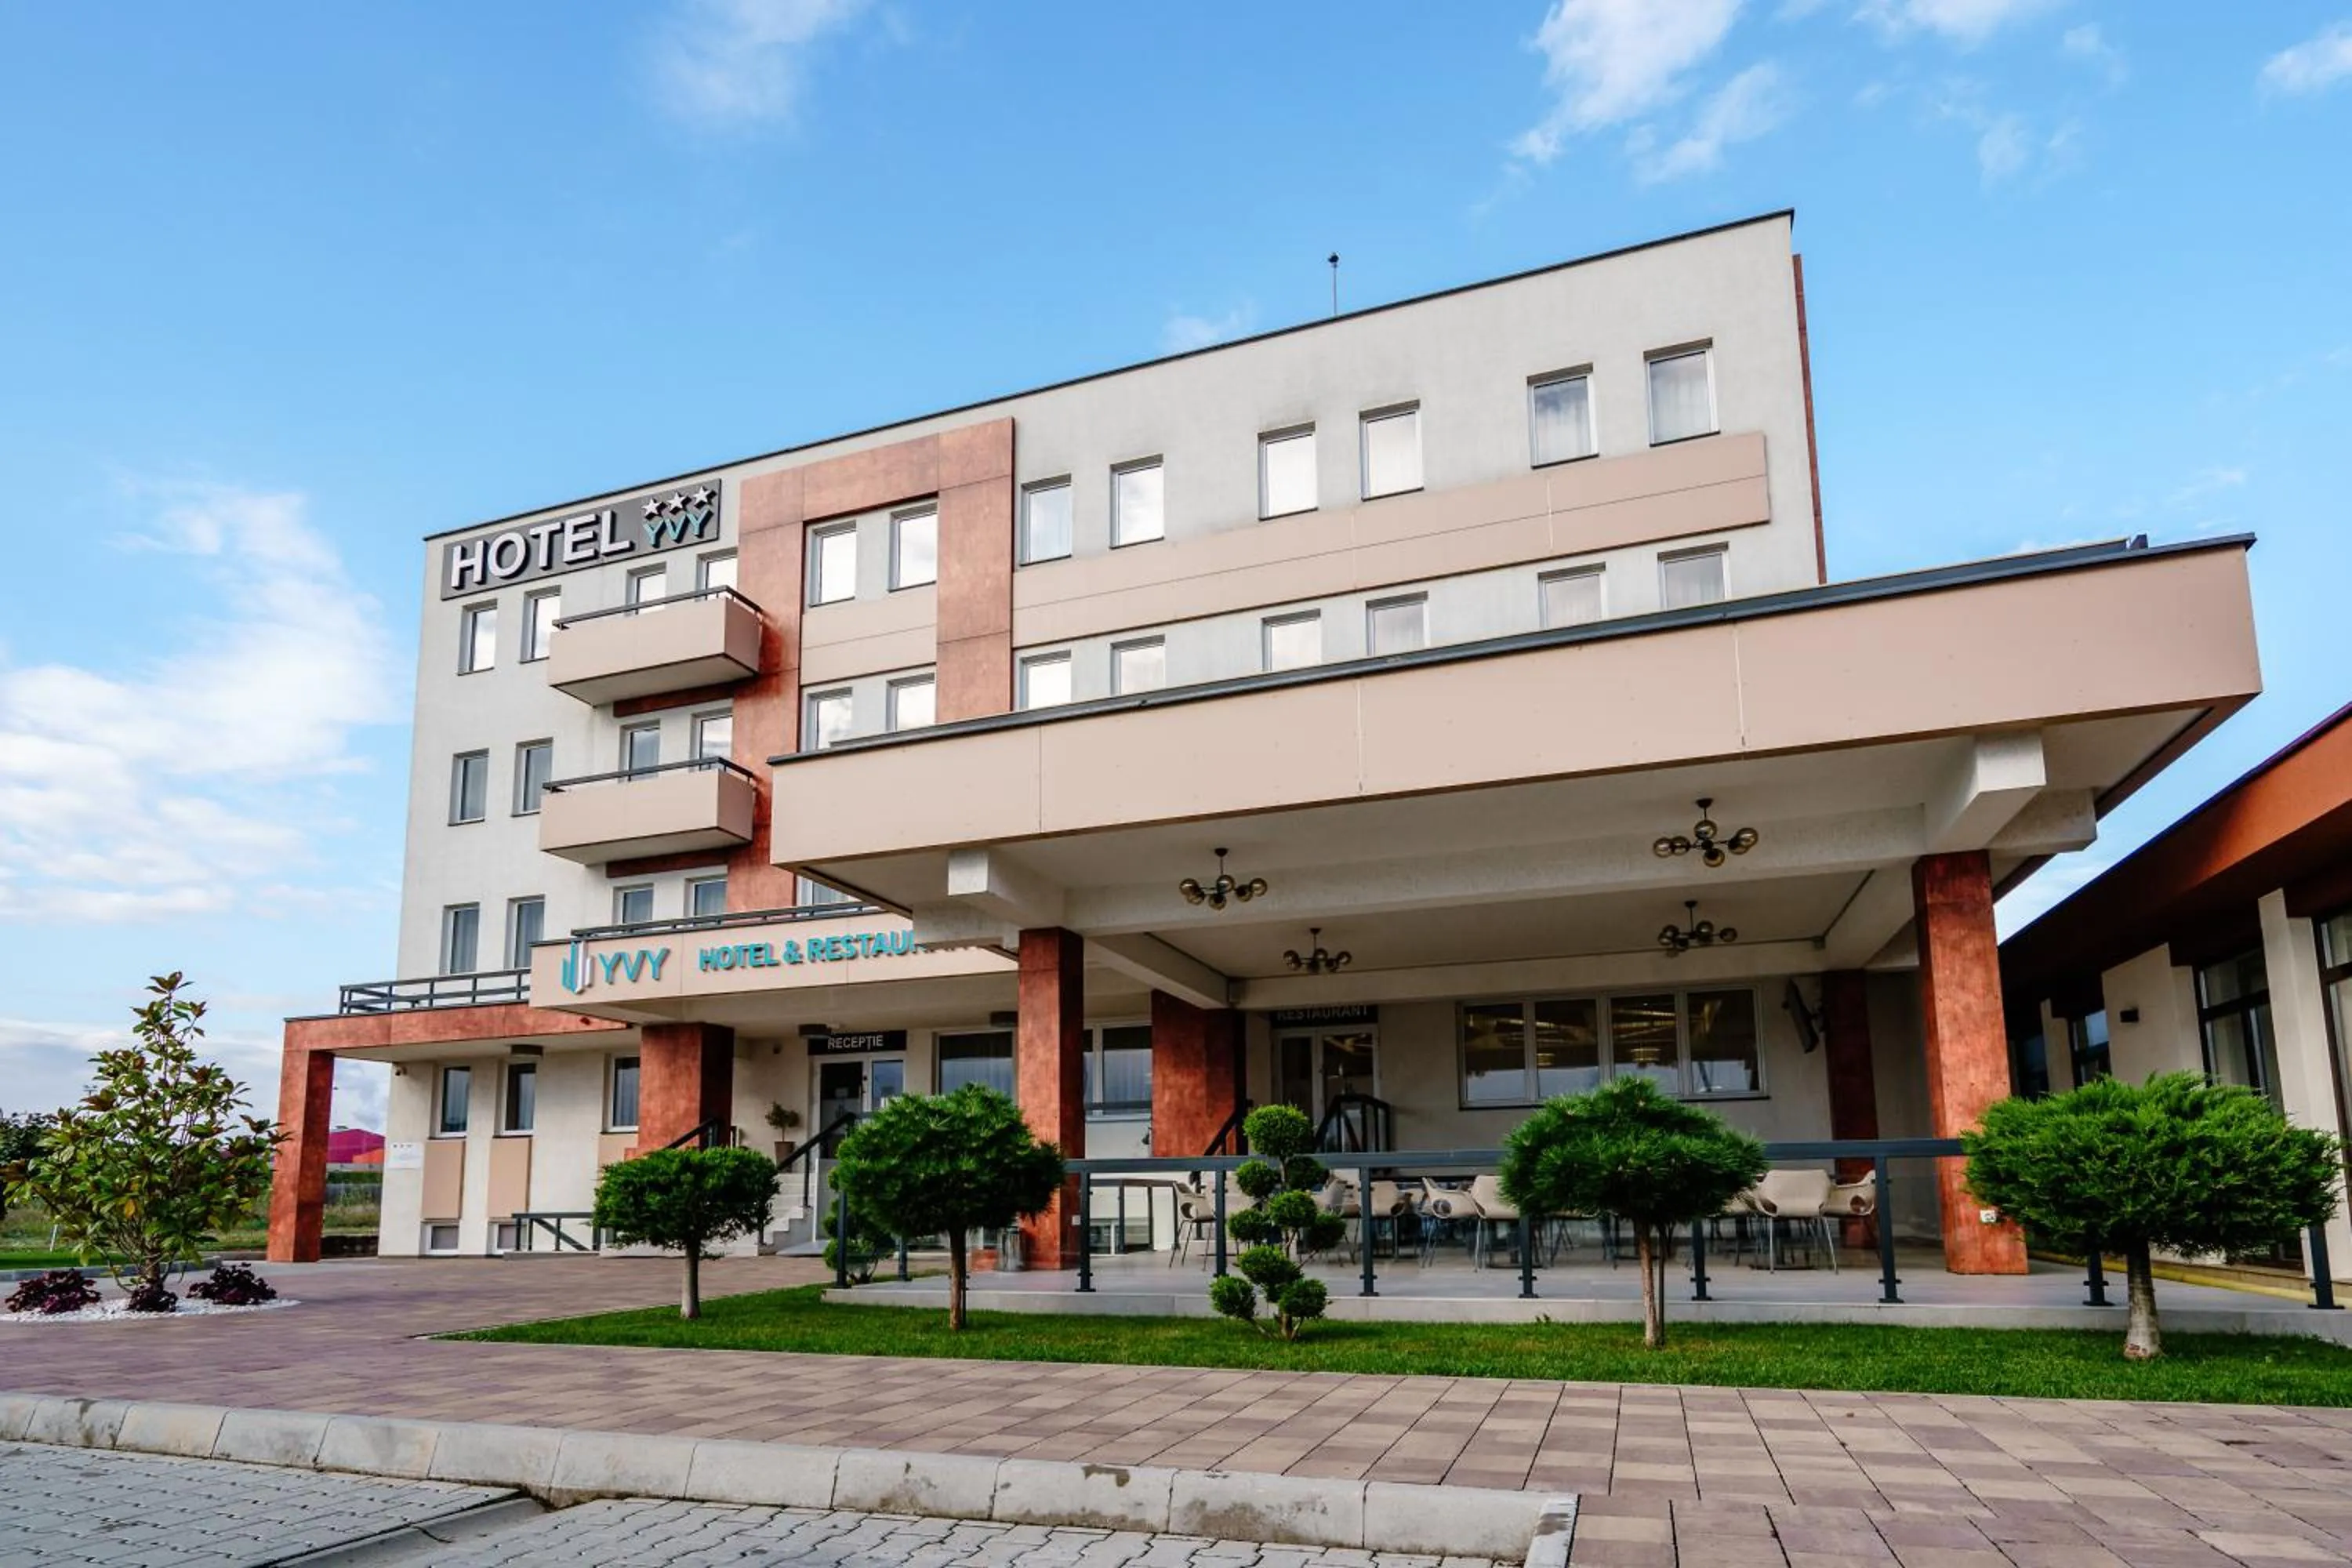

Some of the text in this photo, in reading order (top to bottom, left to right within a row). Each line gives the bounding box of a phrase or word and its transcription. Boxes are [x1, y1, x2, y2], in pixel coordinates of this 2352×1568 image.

[451, 510, 633, 589] HOTEL
[643, 509, 713, 548] YVY
[598, 947, 670, 984] YVY
[699, 942, 779, 971] HOTEL
[783, 940, 803, 964] &
